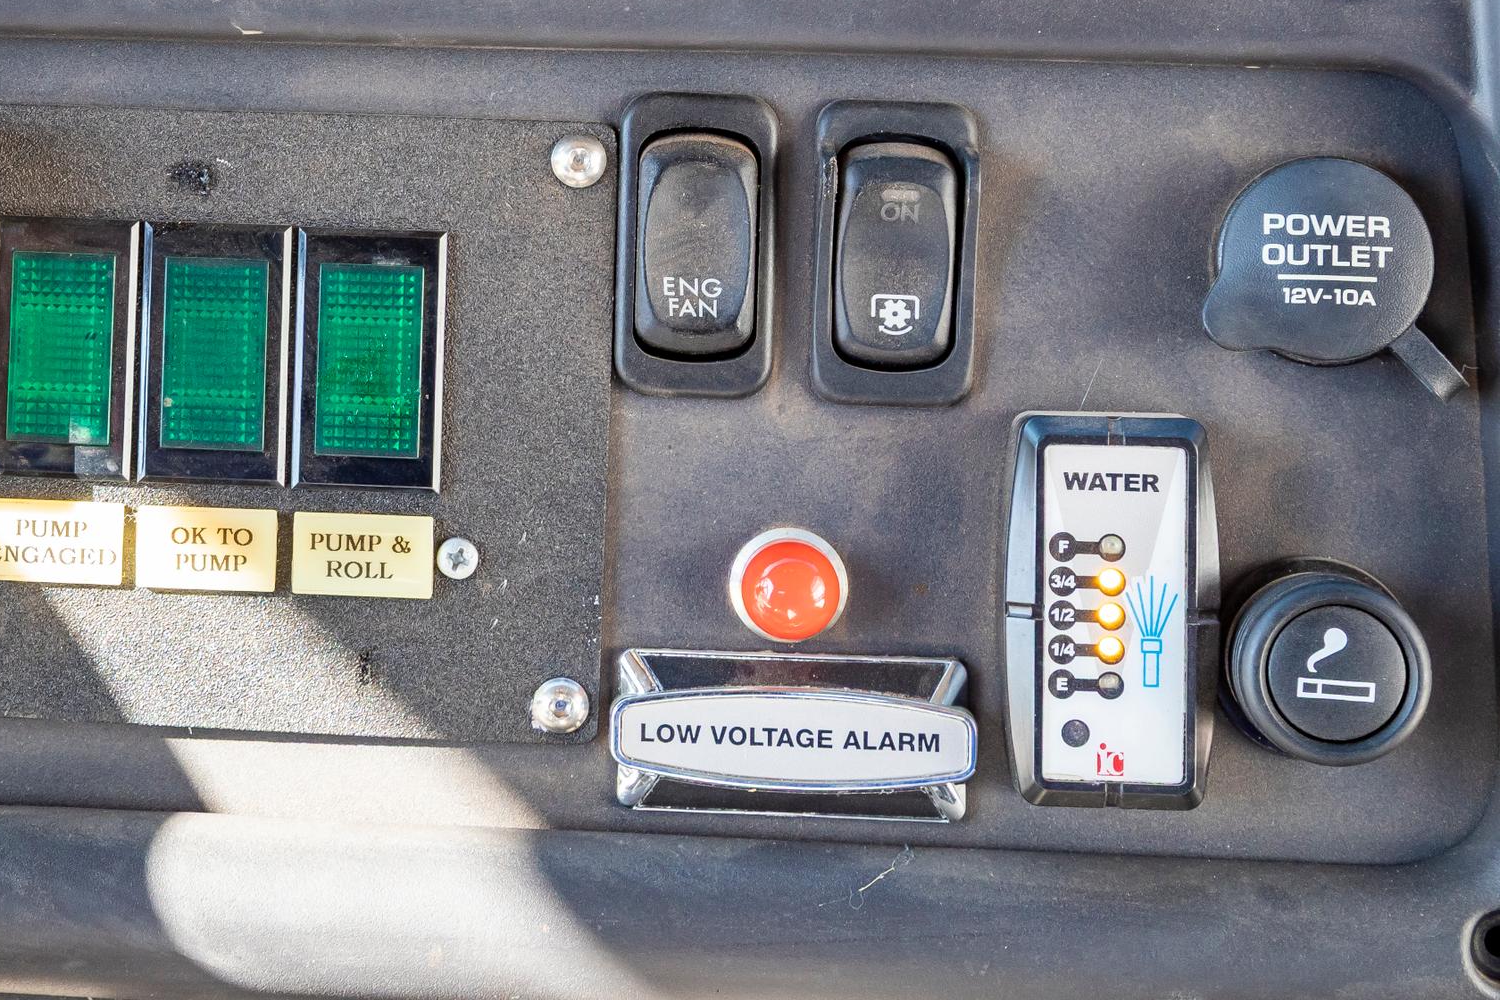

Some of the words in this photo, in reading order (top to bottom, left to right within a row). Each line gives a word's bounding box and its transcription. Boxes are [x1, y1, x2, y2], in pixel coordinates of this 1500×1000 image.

[880, 204, 918, 222] ON
[1263, 213, 1391, 239] POWER
[1262, 243, 1394, 269] OUTLET
[663, 278, 722, 298] ENG
[1282, 286, 1377, 306] 12V-10A
[669, 299, 717, 318] FAN
[1063, 471, 1160, 493] WATER
[16, 519, 88, 538] PUMP
[171, 527, 206, 545] OK
[217, 527, 253, 547] TO
[310, 533, 382, 552] PUMP
[392, 535, 412, 553] &
[1057, 539, 1070, 554] F
[176, 553, 247, 572] PUMP
[326, 560, 394, 580] ROLL
[1050, 574, 1077, 589] 3/4
[1050, 607, 1075, 622] 1/2
[1051, 641, 1076, 657] 1/4
[1056, 677, 1069, 691] E
[641, 723, 701, 743] LOW
[711, 725, 834, 749] VOLTAGE
[842, 731, 941, 752] ALARM
